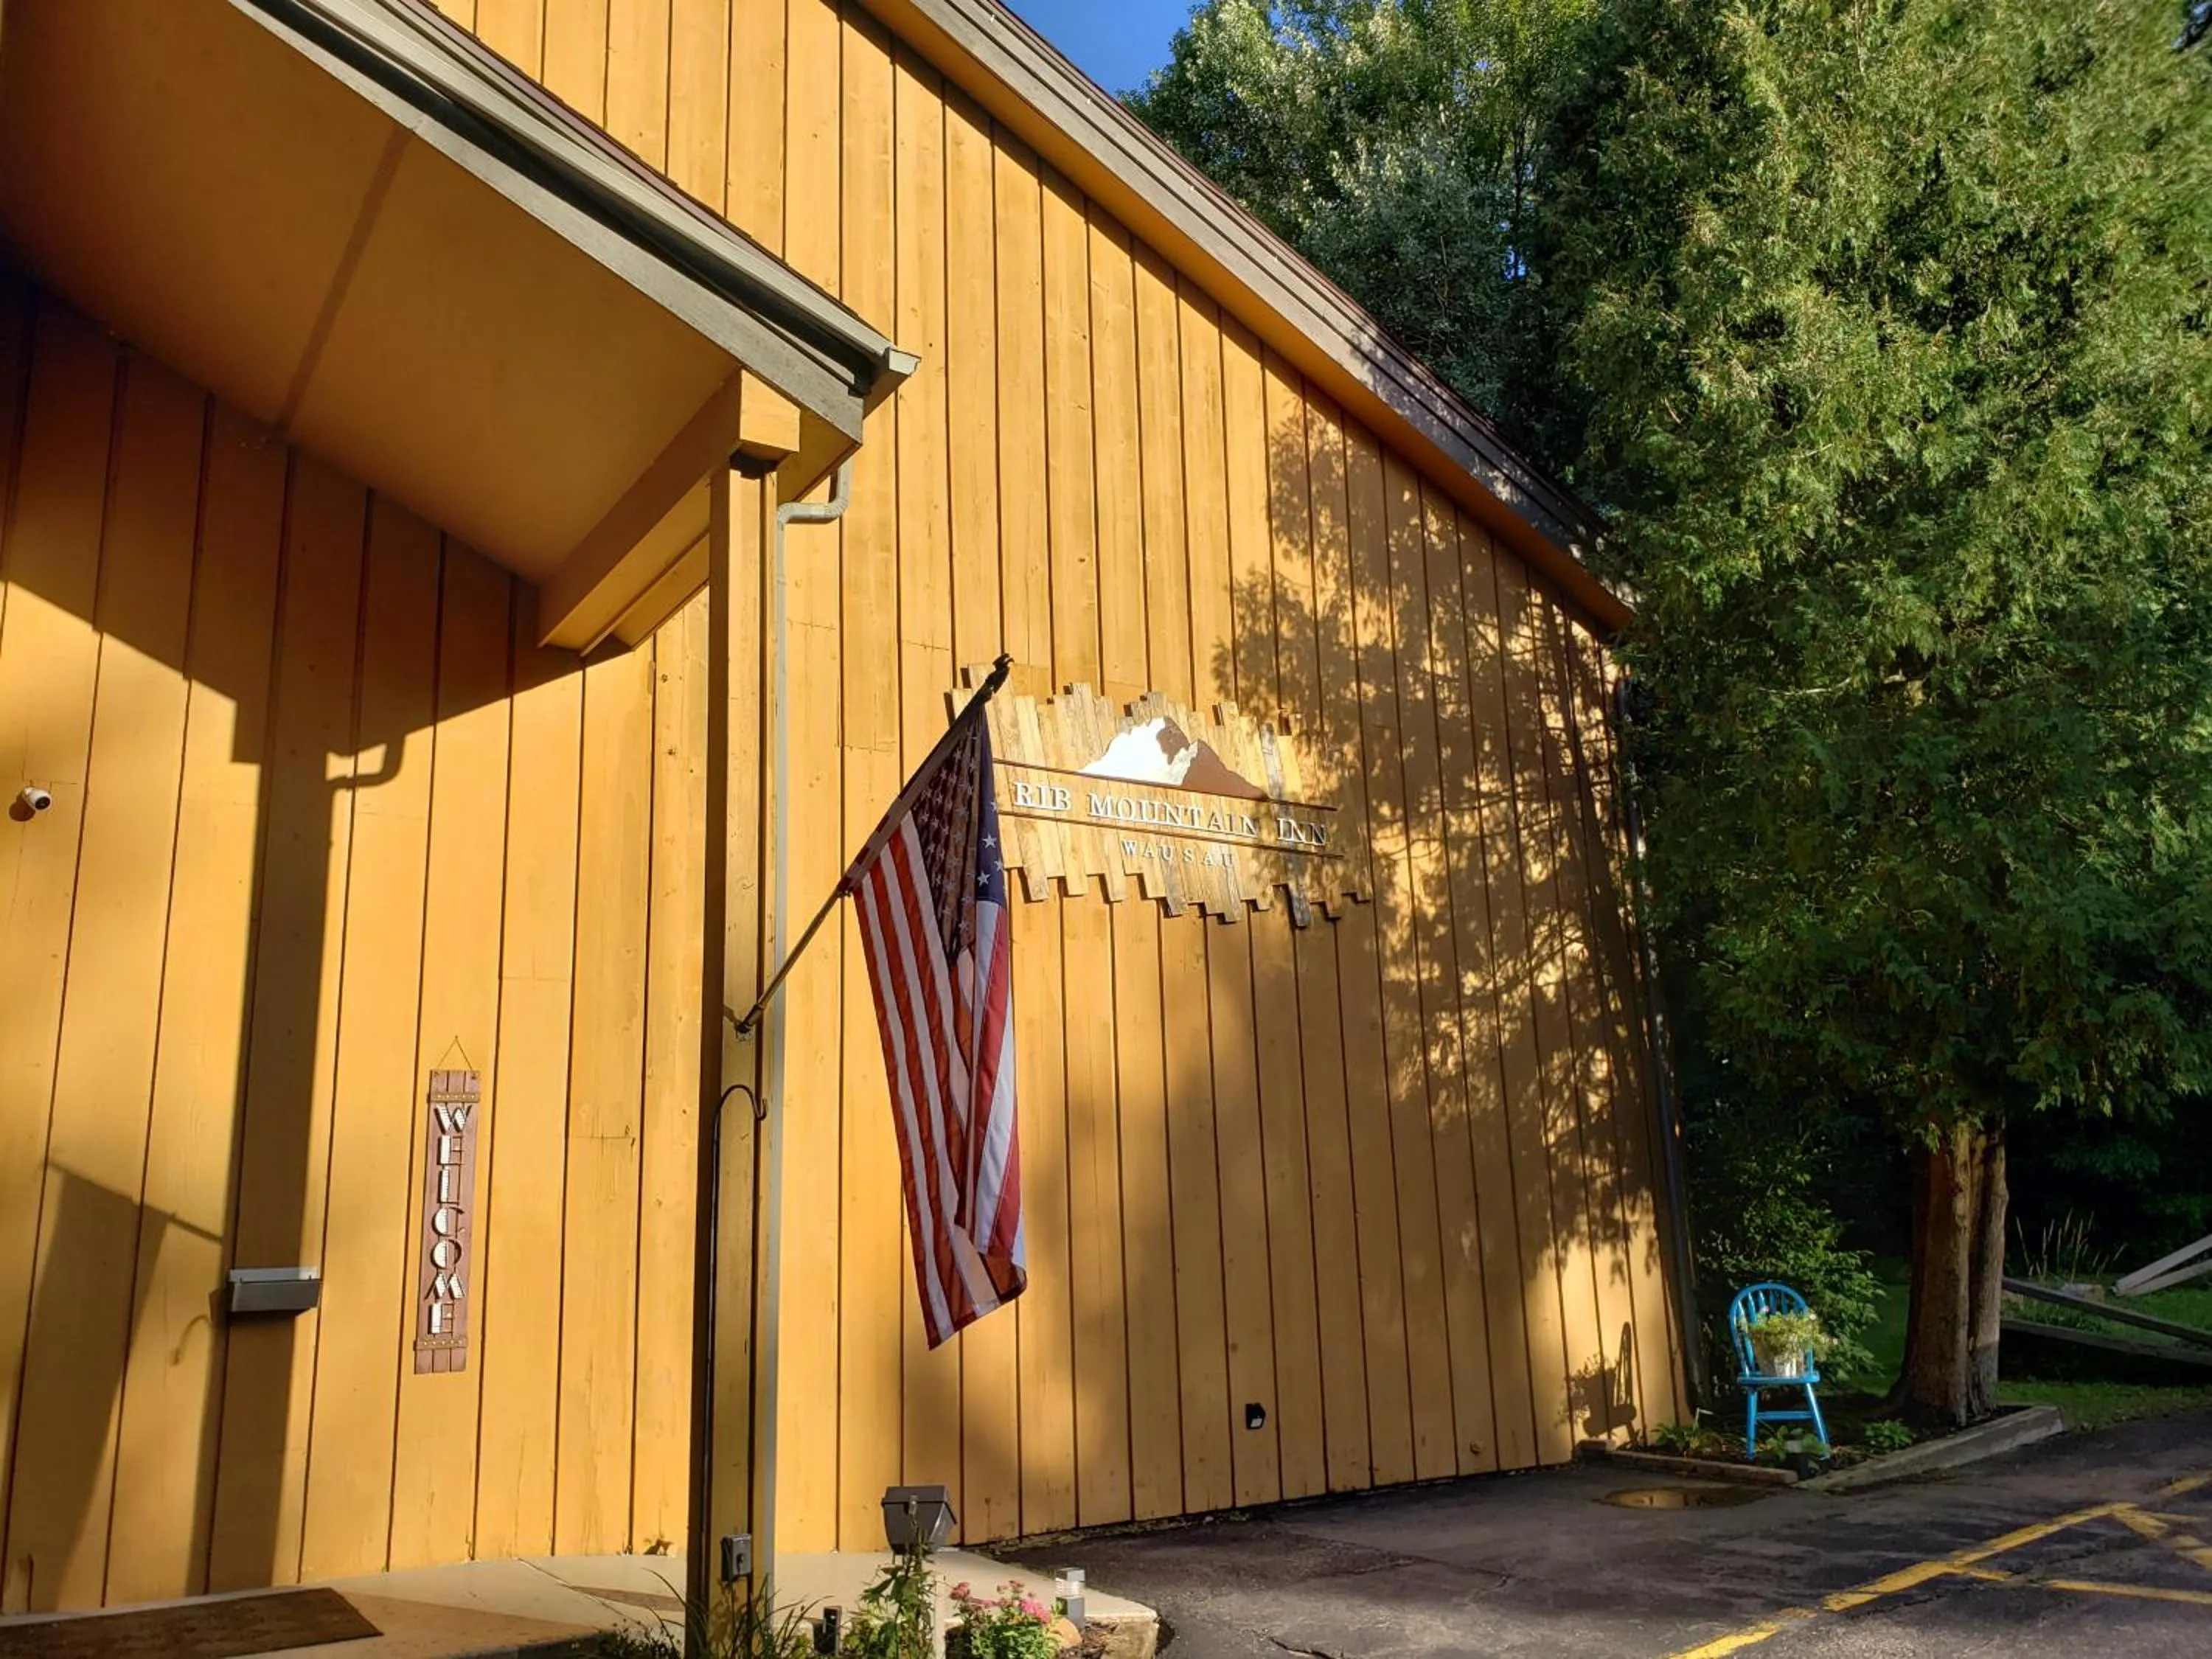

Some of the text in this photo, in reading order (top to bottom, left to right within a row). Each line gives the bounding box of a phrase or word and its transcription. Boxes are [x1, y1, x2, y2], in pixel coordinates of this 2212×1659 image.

[1014, 782, 1326, 846] RIB MOUNTAIN INN
[1122, 839, 1236, 867] WAUSAU
[425, 1105, 472, 1335] WELCOME
